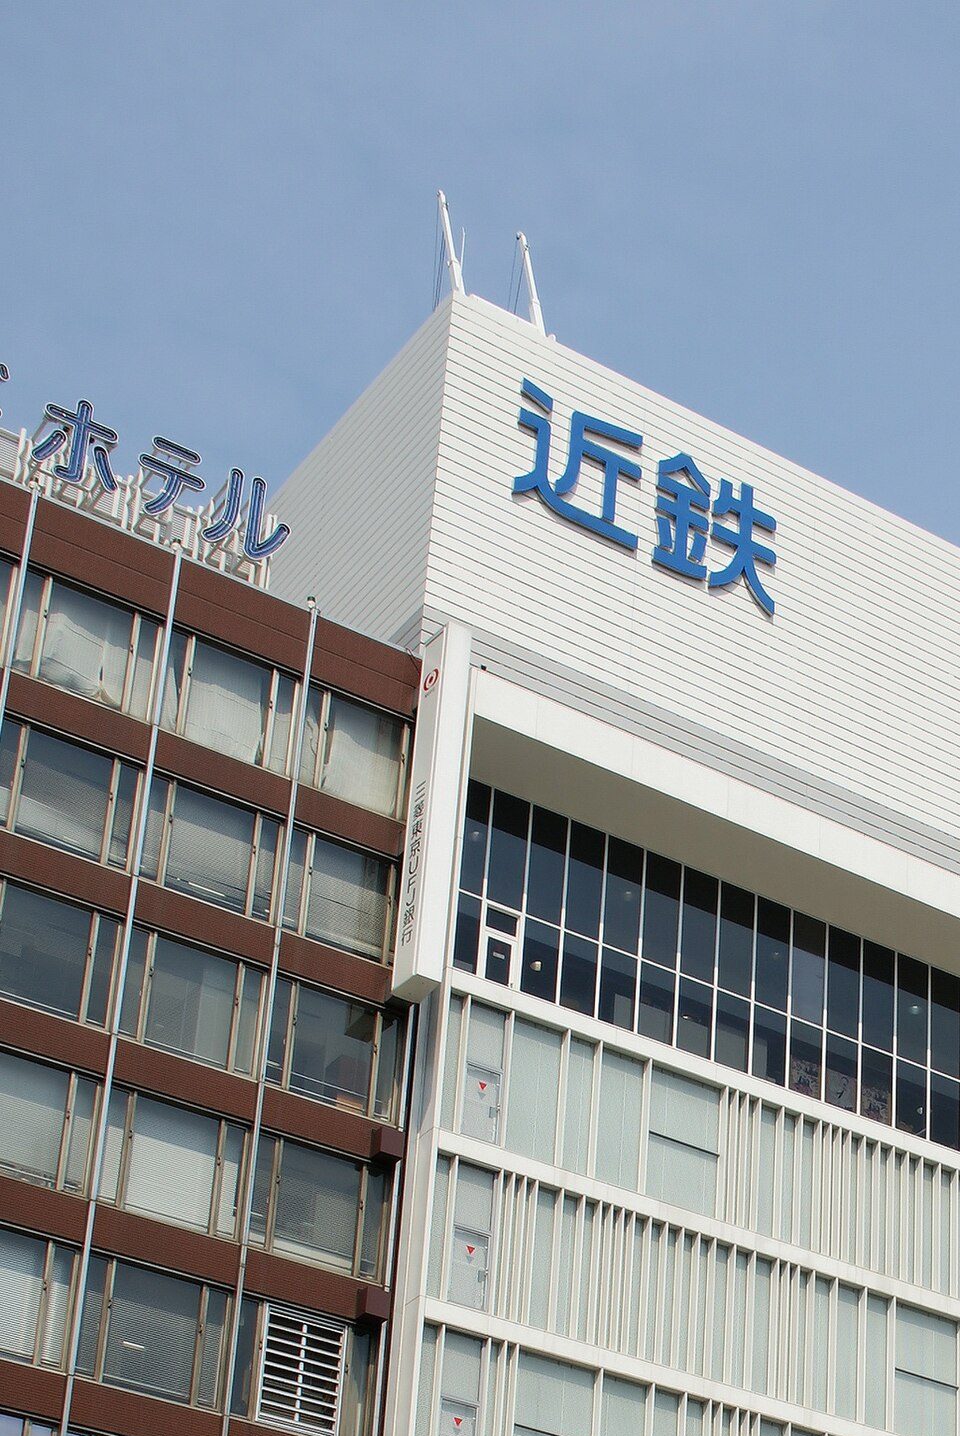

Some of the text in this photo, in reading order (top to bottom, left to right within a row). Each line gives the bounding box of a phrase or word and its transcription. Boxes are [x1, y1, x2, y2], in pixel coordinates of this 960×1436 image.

[0, 363, 290, 560] ホテル
[513, 378, 778, 617] 近鉄
